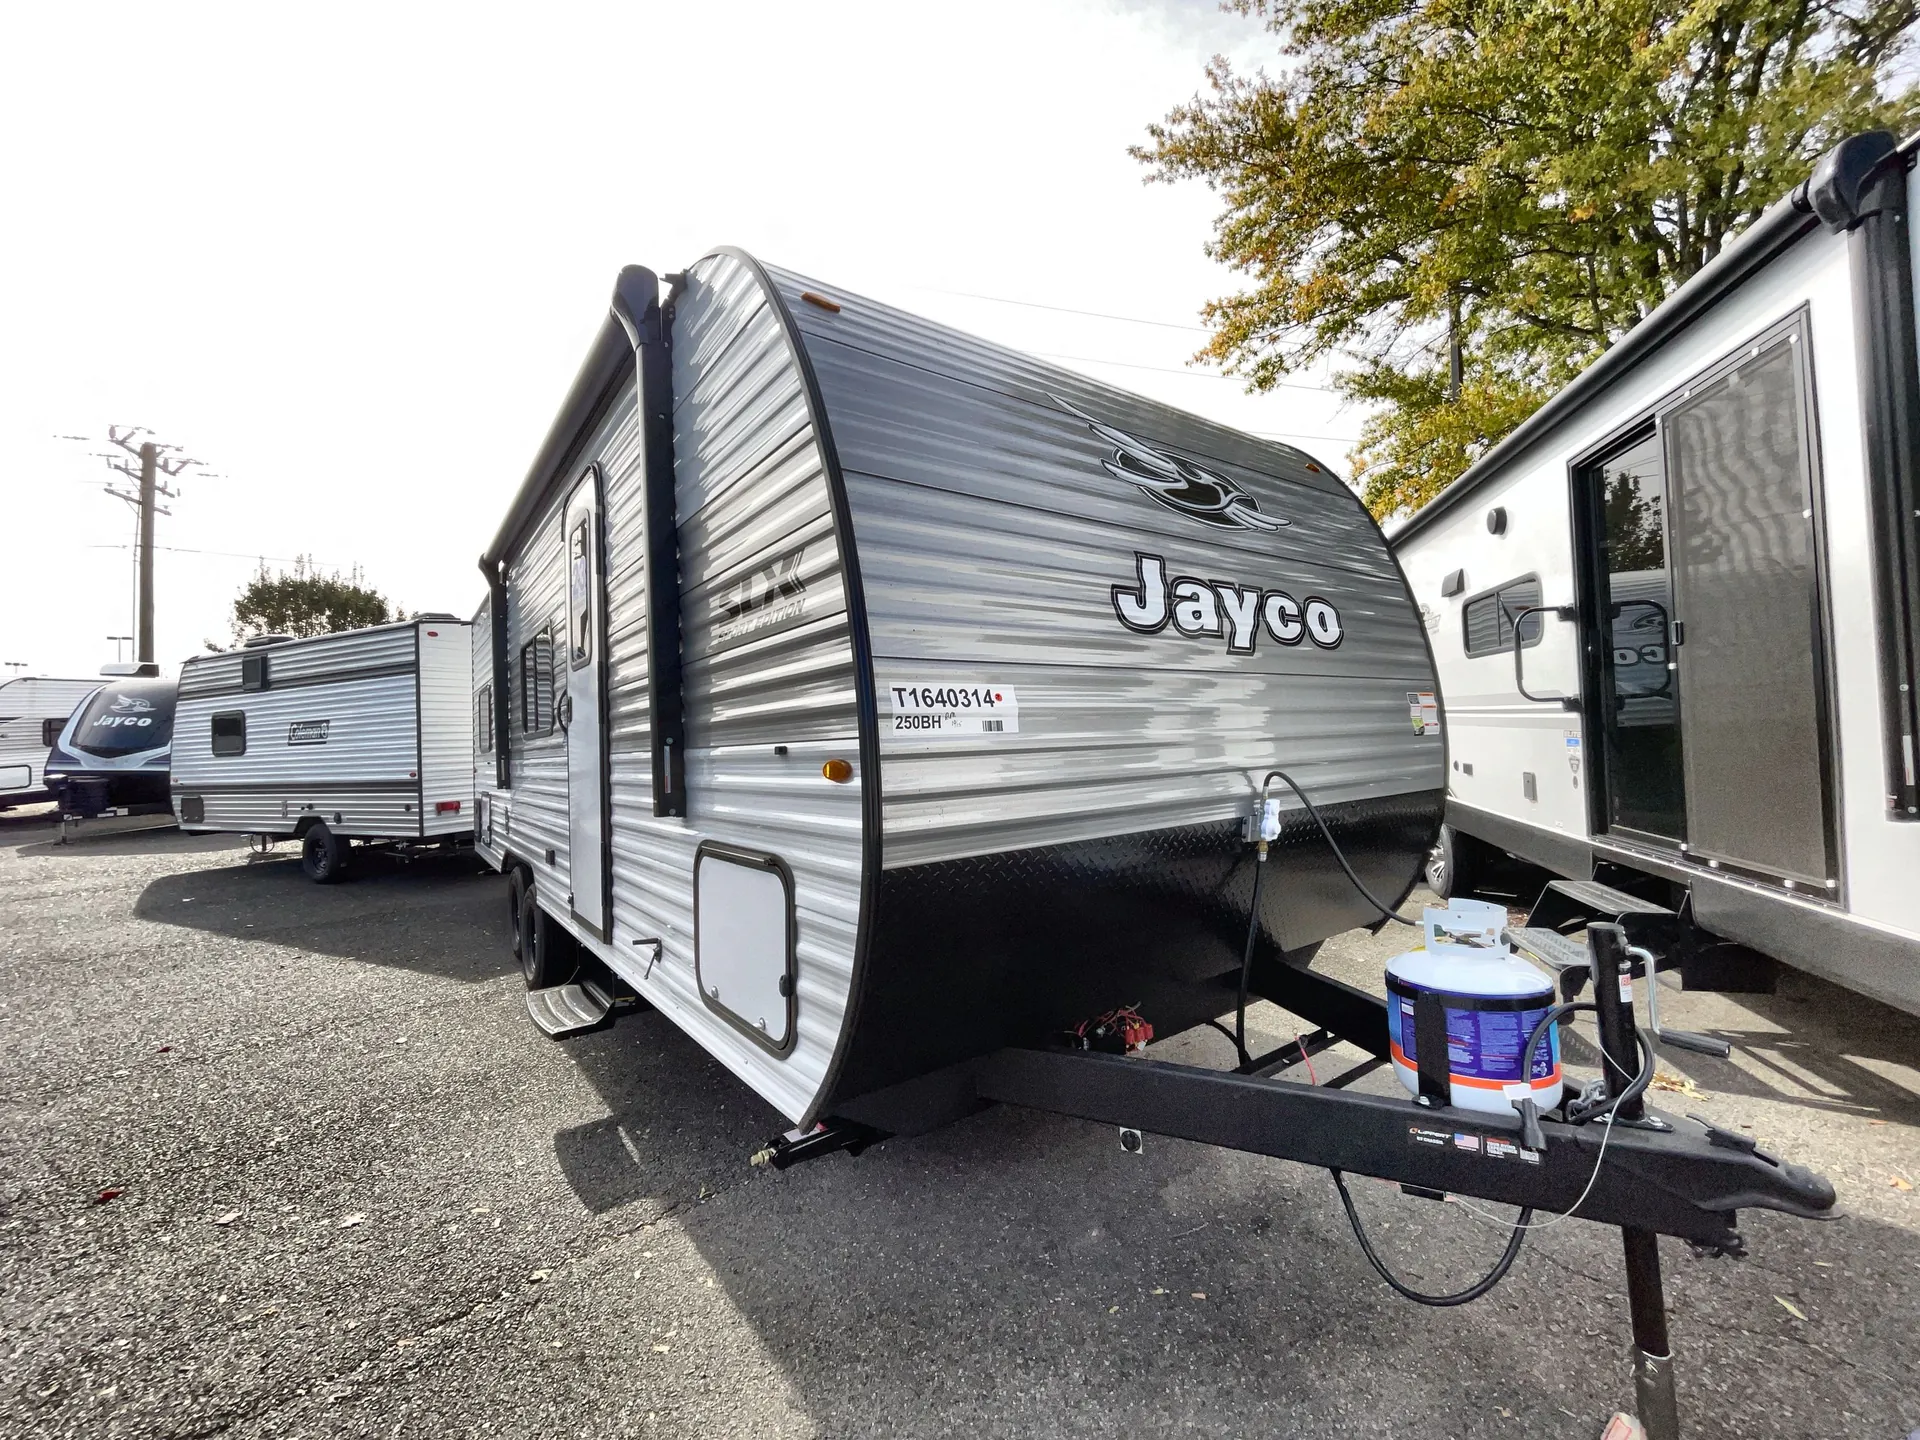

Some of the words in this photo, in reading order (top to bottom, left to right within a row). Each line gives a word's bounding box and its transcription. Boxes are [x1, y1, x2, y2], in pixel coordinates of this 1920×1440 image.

[1110, 550, 1344, 656] Jayco
[892, 687, 995, 708] T1640314
[93, 715, 152, 727] Jayco
[895, 715, 942, 730] 250BH
